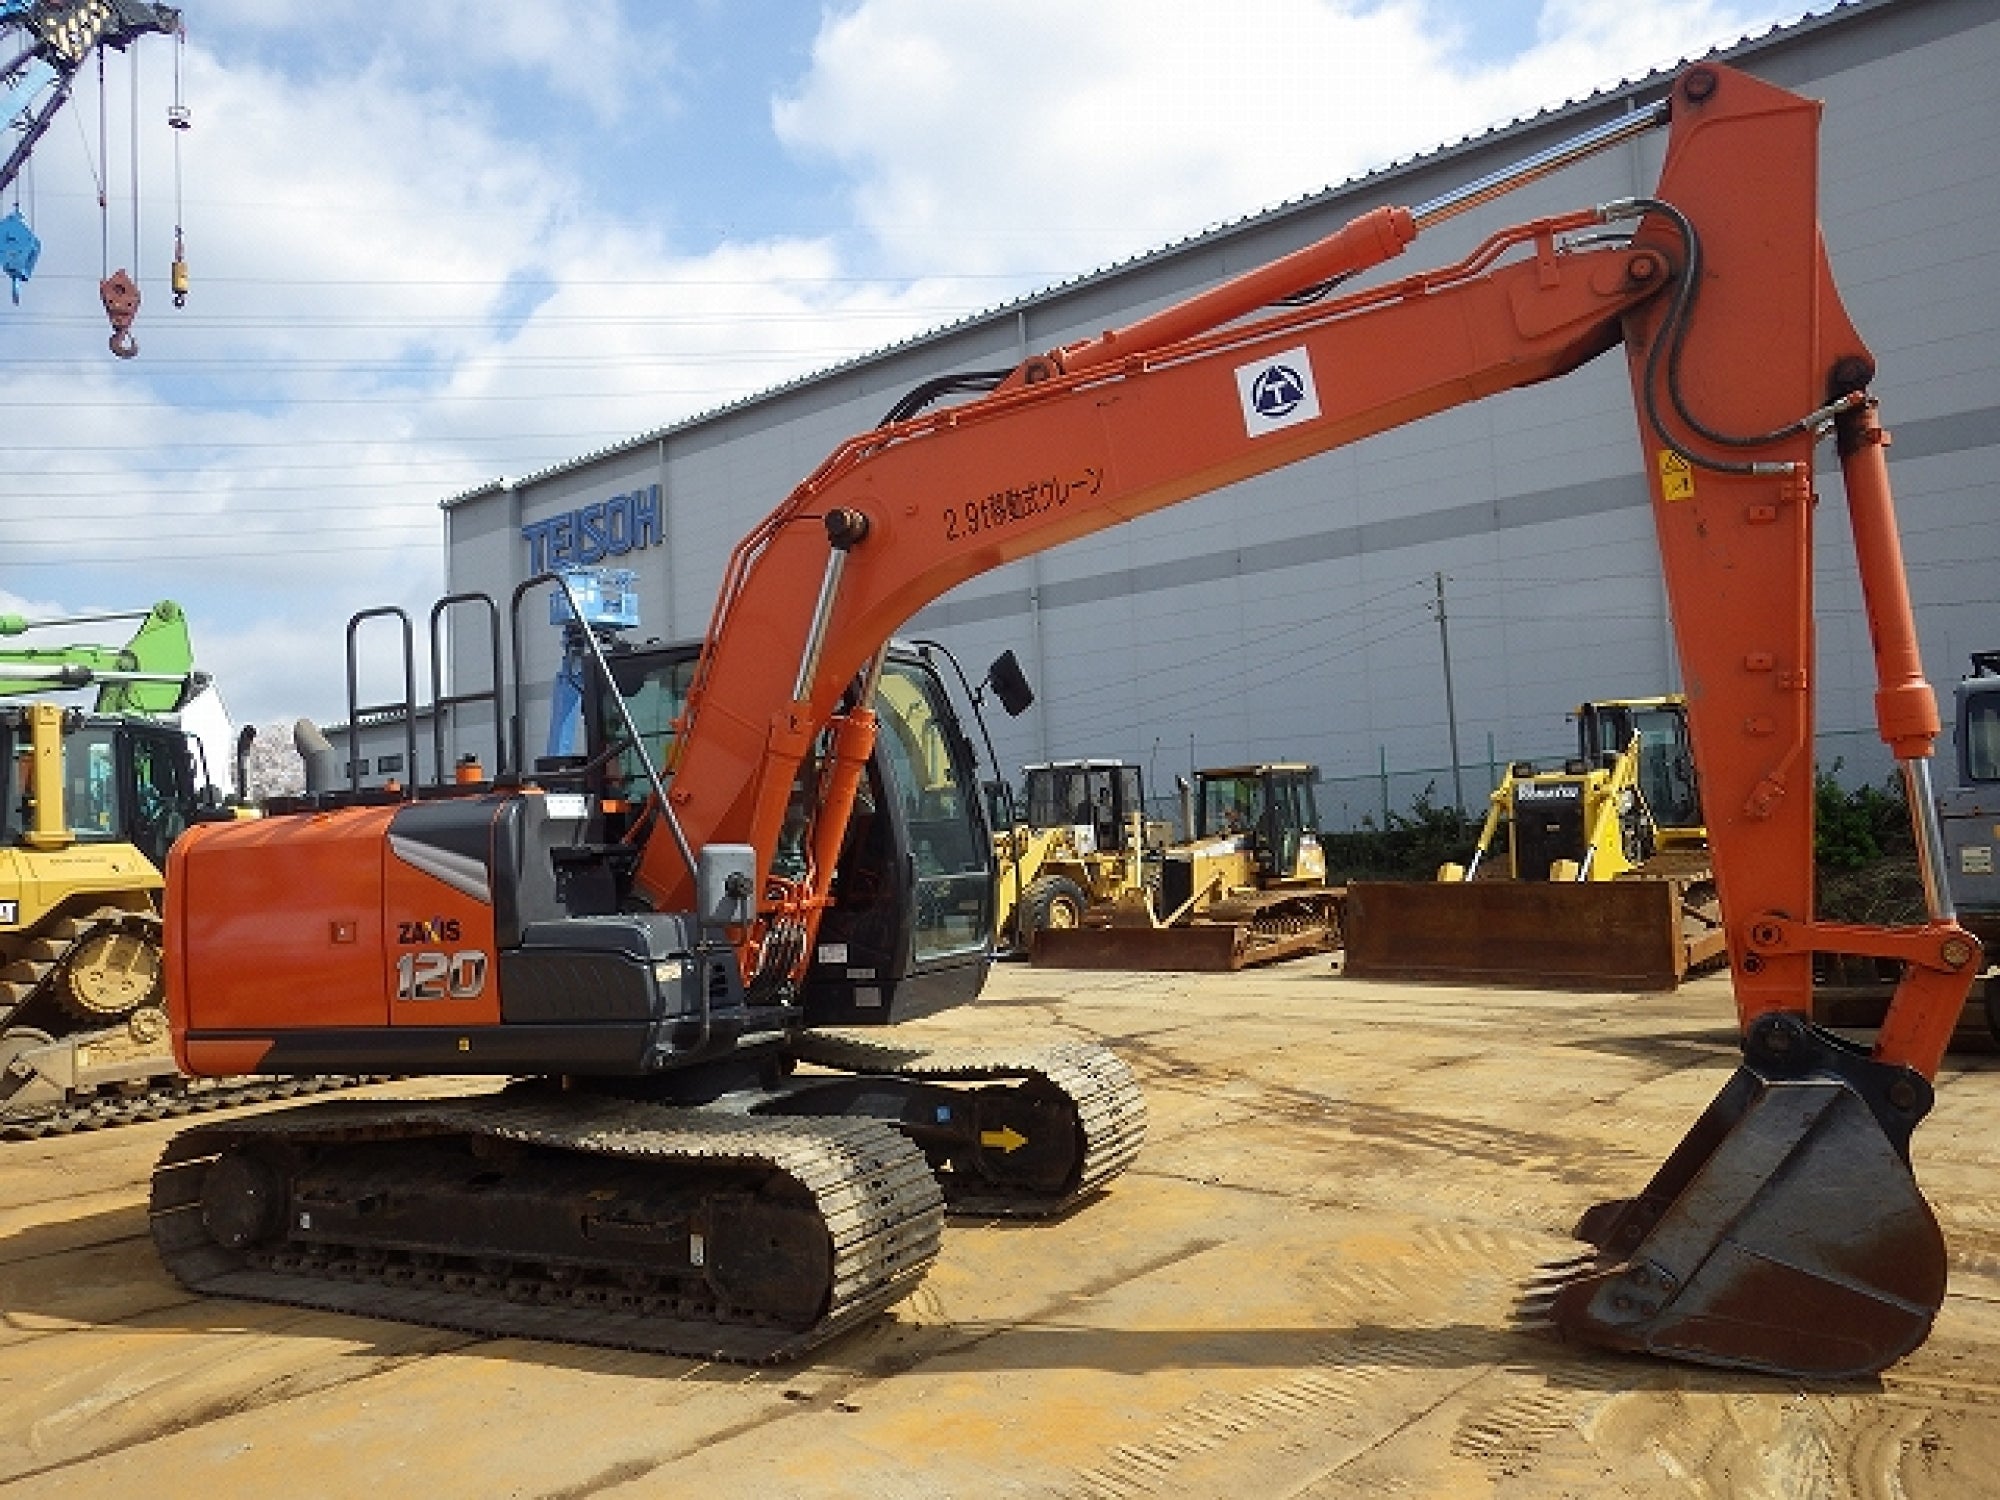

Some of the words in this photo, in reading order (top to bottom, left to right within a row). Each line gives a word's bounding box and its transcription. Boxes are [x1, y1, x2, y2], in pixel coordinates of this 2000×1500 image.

[521, 484, 664, 576] TEISOH
[397, 916, 461, 944] ZAXIS
[396, 949, 488, 1000] 120
